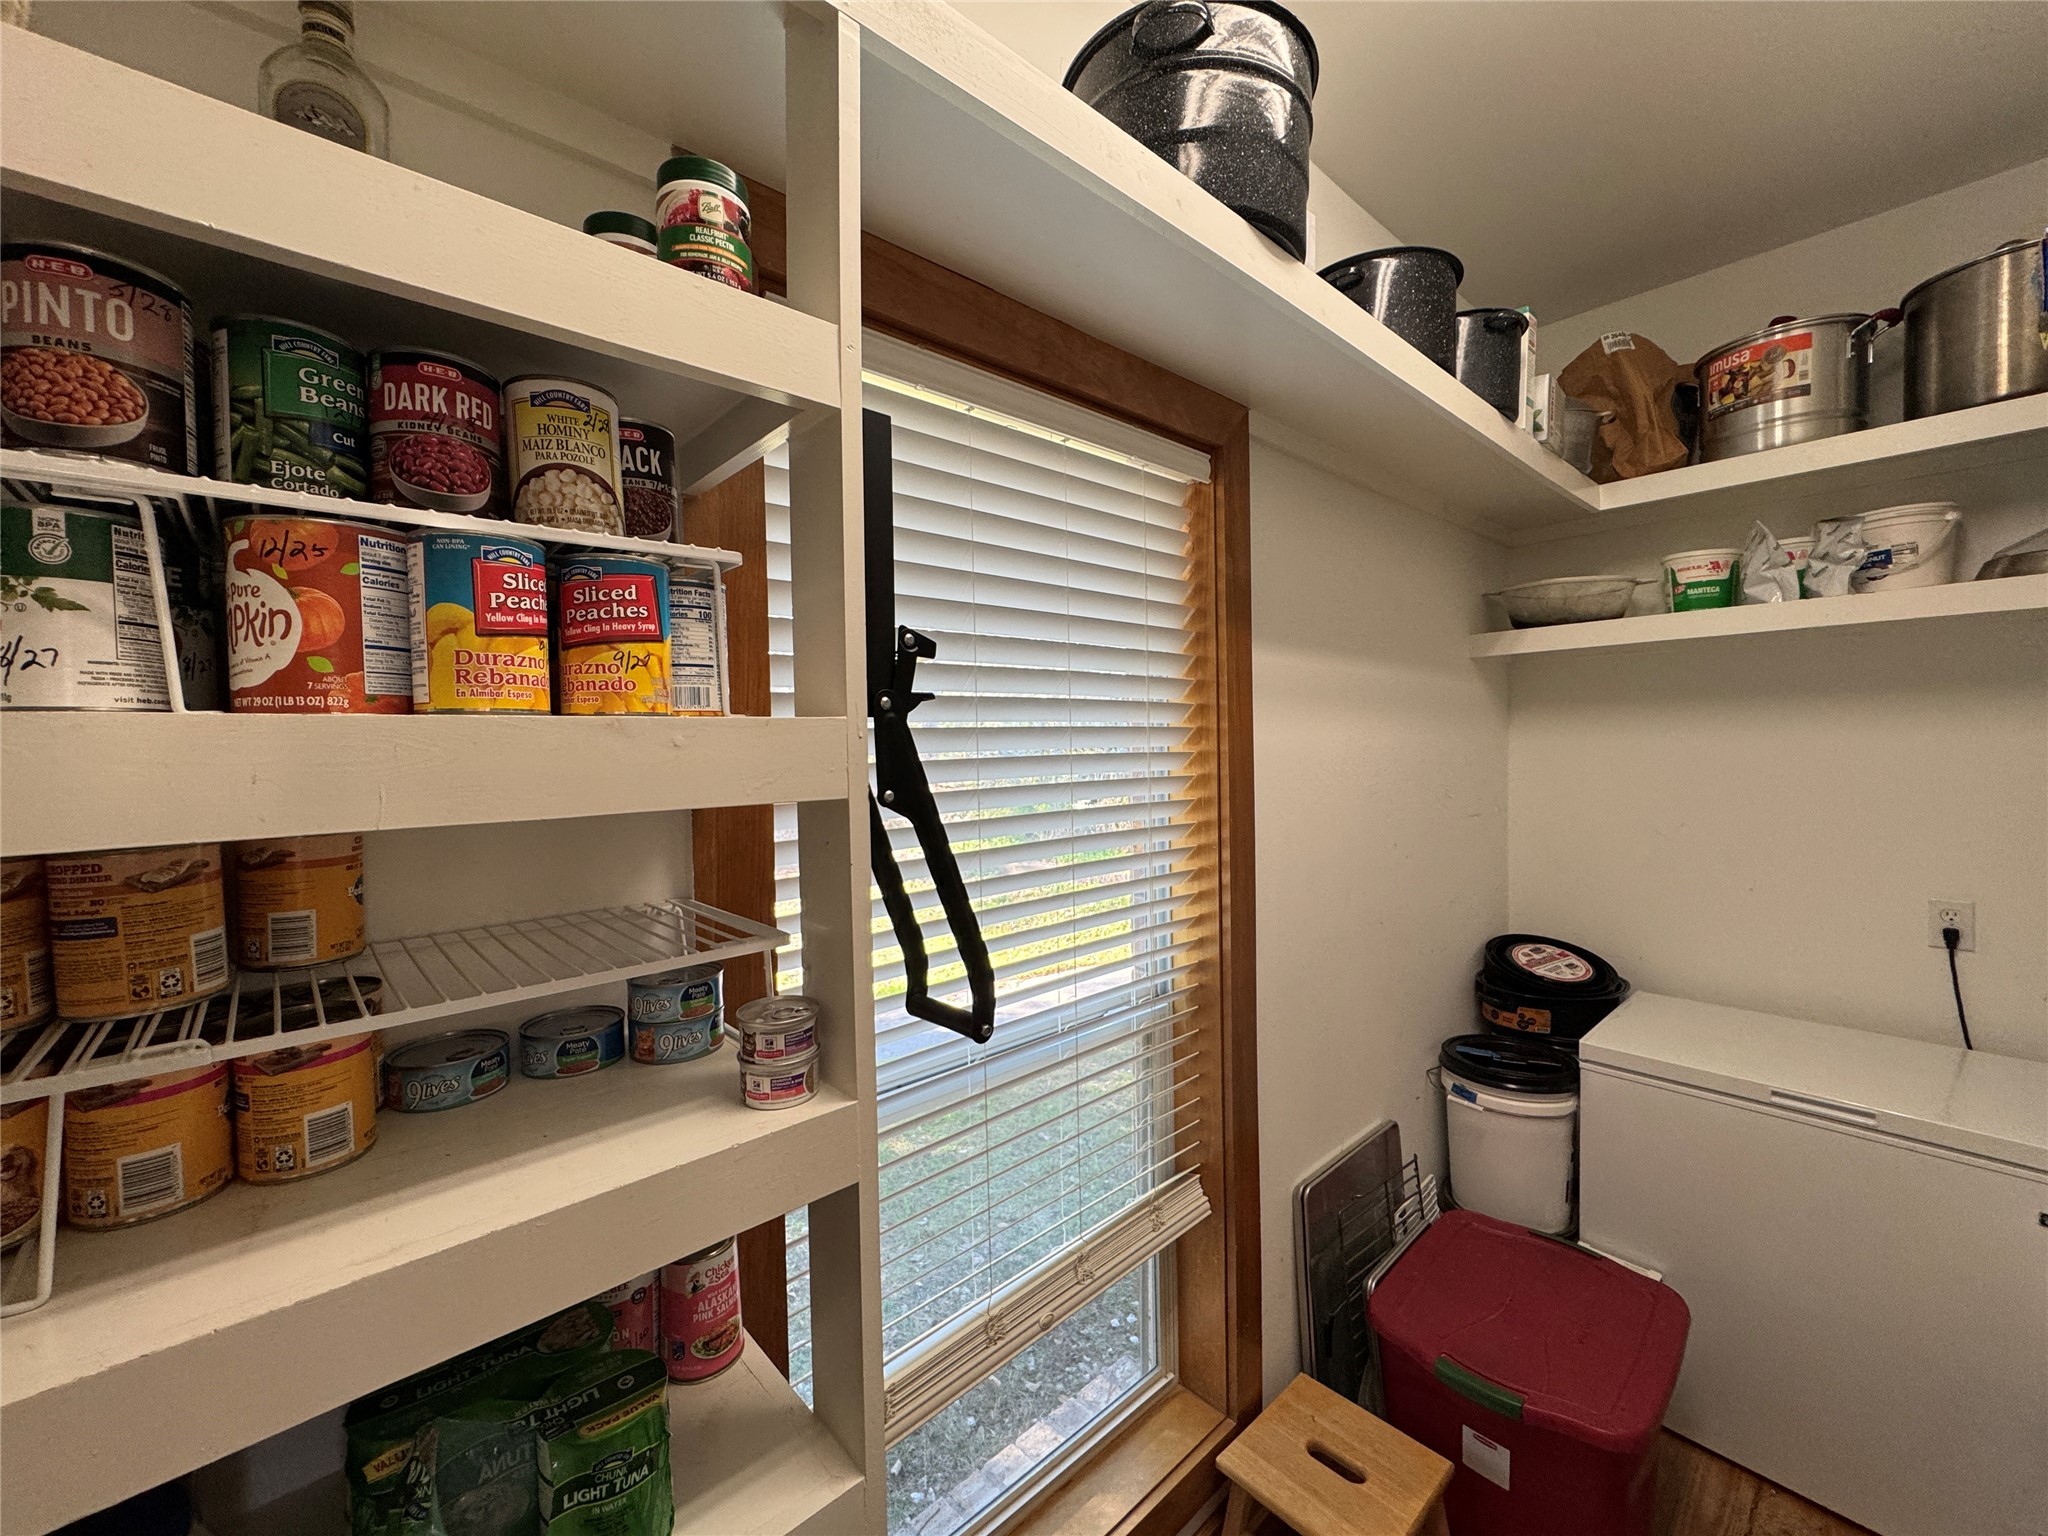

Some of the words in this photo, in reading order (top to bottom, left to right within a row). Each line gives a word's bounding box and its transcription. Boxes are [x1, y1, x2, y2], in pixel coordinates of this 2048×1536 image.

[701, 202, 721, 214] Ball
[689, 234, 715, 244] CLASSIC
[715, 238, 735, 252] PECTIN
[2, 280, 134, 342] PINTO
[32, 335, 92, 352] BEANS
[298, 367, 364, 400] Green
[299, 386, 365, 418] Beans
[384, 382, 448, 415] DARK
[456, 391, 492, 430] RED
[534, 394, 546, 406] HILL
[546, 392, 574, 405] COUNTRY
[574, 398, 590, 412] FARE
[546, 414, 580, 426] WHITE
[332, 432, 356, 448] Cut
[398, 422, 442, 432] KIDNEY
[446, 426, 483, 444] BEANS
[537, 423, 590, 440] HOMINY
[522, 438, 554, 452] MAIZ
[556, 438, 606, 459] BLANCO
[535, 451, 558, 460] PARA
[560, 452, 595, 466] POZOLE
[622, 444, 662, 476] ACK
[270, 460, 326, 481] Ejote
[271, 478, 340, 498] Cortado
[622, 478, 646, 486] EANS
[114, 526, 145, 542] Nutrit
[259, 530, 328, 567] 12/25
[360, 537, 406, 554] Nutrition
[362, 557, 381, 565] Serving
[487, 550, 498, 560] HILL
[498, 550, 520, 558] COUNTRY
[520, 554, 530, 566] FARE
[362, 576, 400, 589] Calories
[570, 568, 588, 576] COUNTRY
[588, 570, 599, 580] FARE
[230, 582, 260, 602] pure
[573, 584, 638, 604] Sliced
[670, 588, 692, 596] trition
[694, 590, 711, 598] Facts
[1686, 586, 1720, 596] MANTECA
[489, 592, 548, 610] Peach
[485, 612, 514, 622] Yellow
[516, 613, 532, 625] Cling
[566, 602, 649, 624] Peaches
[698, 611, 712, 620] 100
[228, 601, 292, 654] pkin
[564, 626, 582, 637] Yellow
[584, 624, 600, 634] Cling
[602, 622, 610, 631] In
[612, 622, 636, 632] Heavy
[638, 621, 656, 632] Syrup
[454, 650, 544, 670] Durazno
[559, 662, 621, 676] urazno
[306, 682, 313, 690] 7
[314, 682, 348, 690] SERVINGS
[562, 676, 636, 692] ebanado
[242, 698, 252, 707] WT
[253, 696, 260, 706] 29
[262, 696, 274, 706] OZ
[283, 696, 294, 706] LB
[296, 696, 305, 706] 13
[306, 696, 325, 708] OZ)
[326, 696, 350, 708] 822g
[456, 688, 466, 698] En
[508, 690, 532, 700] Espeso
[576, 696, 599, 704] Espeso
[688, 985, 708, 996] Meaty
[566, 1040, 590, 1050] Meaty
[480, 1056, 500, 1069] Meaty
[715, 1270, 730, 1283] Sea
[692, 1309, 714, 1323] PINK
[416, 1370, 470, 1399] LIGHT
[480, 1346, 533, 1370] TUNA
[545, 1387, 600, 1420] LIGHT
[623, 1393, 660, 1416] VALUE
[586, 1415, 620, 1434] PACK
[594, 1464, 628, 1483] CHUNK
[563, 1483, 610, 1510] LIGHT
[613, 1464, 649, 1493] TUNA
[592, 1506, 600, 1514] IN
[602, 1497, 627, 1512] WATER
